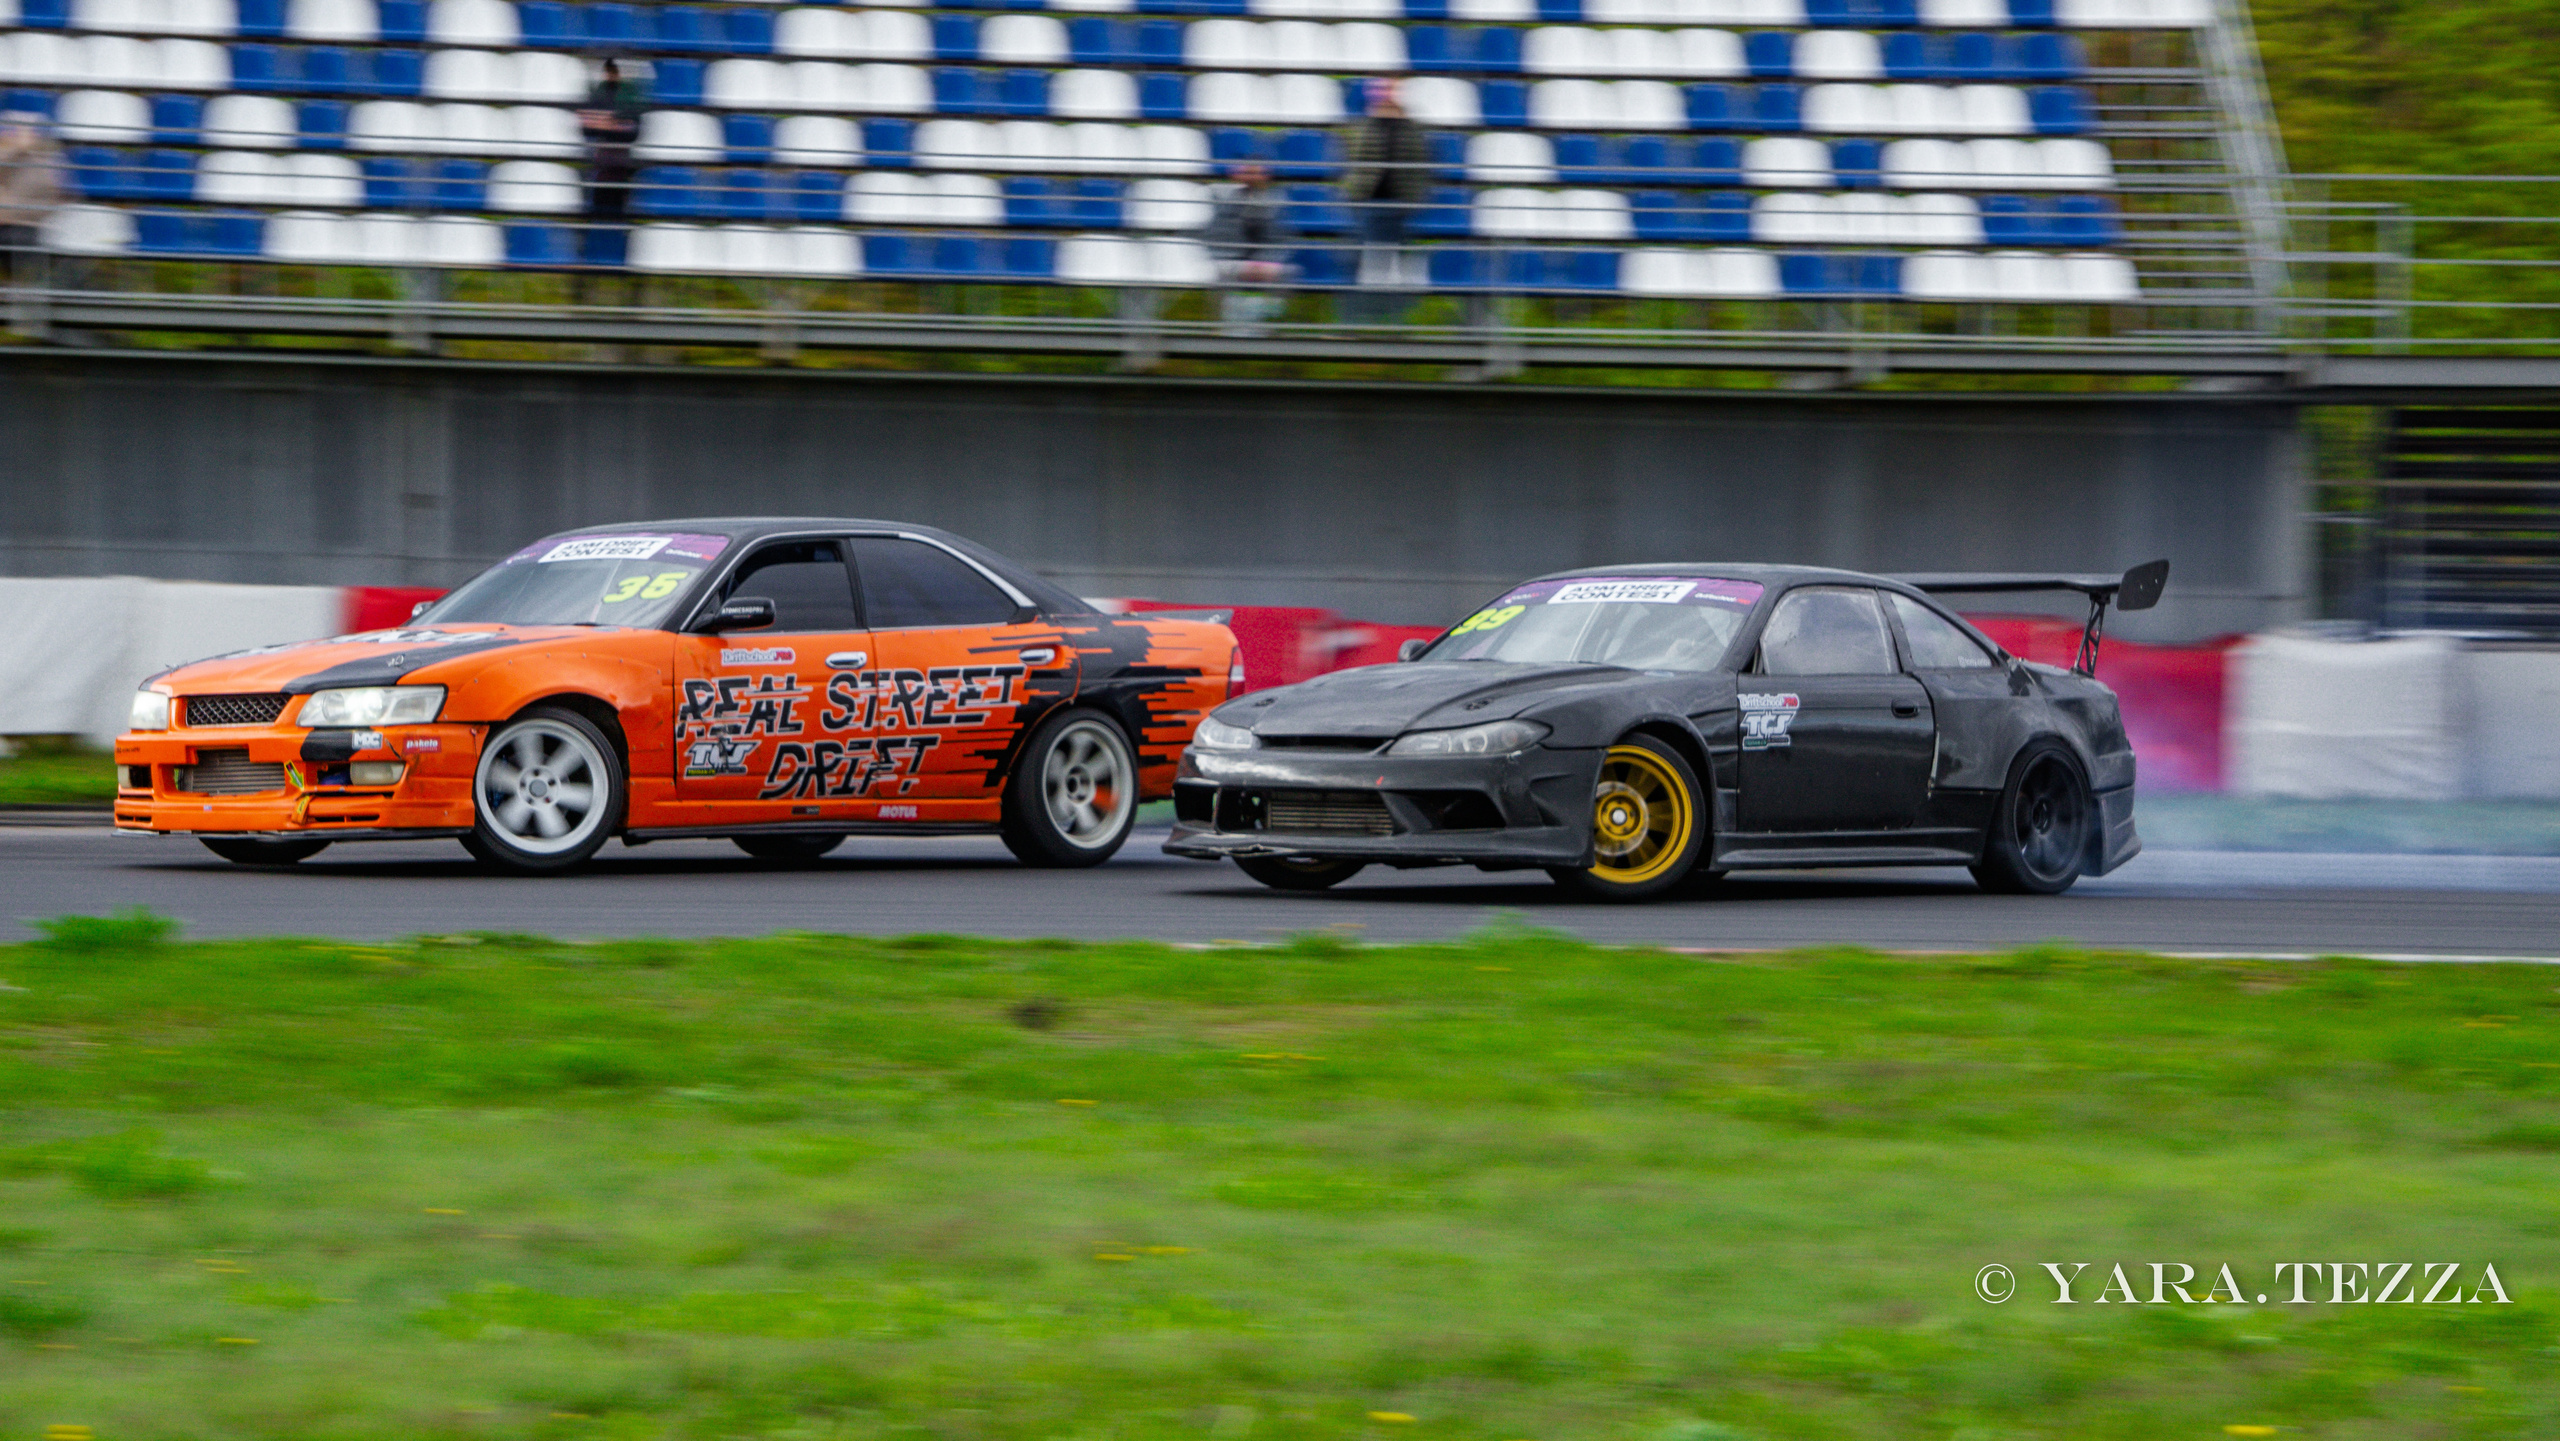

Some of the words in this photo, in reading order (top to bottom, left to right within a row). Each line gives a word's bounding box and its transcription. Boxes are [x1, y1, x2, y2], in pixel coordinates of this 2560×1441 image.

[550, 548, 649, 559] CONTEST
[563, 540, 604, 550] ADM
[604, 539, 660, 547] DRIFT
[1560, 591, 1676, 601] CONTEST
[1449, 604, 1526, 636] 99
[676, 673, 812, 740] REAL
[820, 665, 1026, 730] STREET
[1745, 713, 1792, 736] TCS
[758, 734, 941, 800] DRIFT
[878, 805, 918, 818] MOTUL
